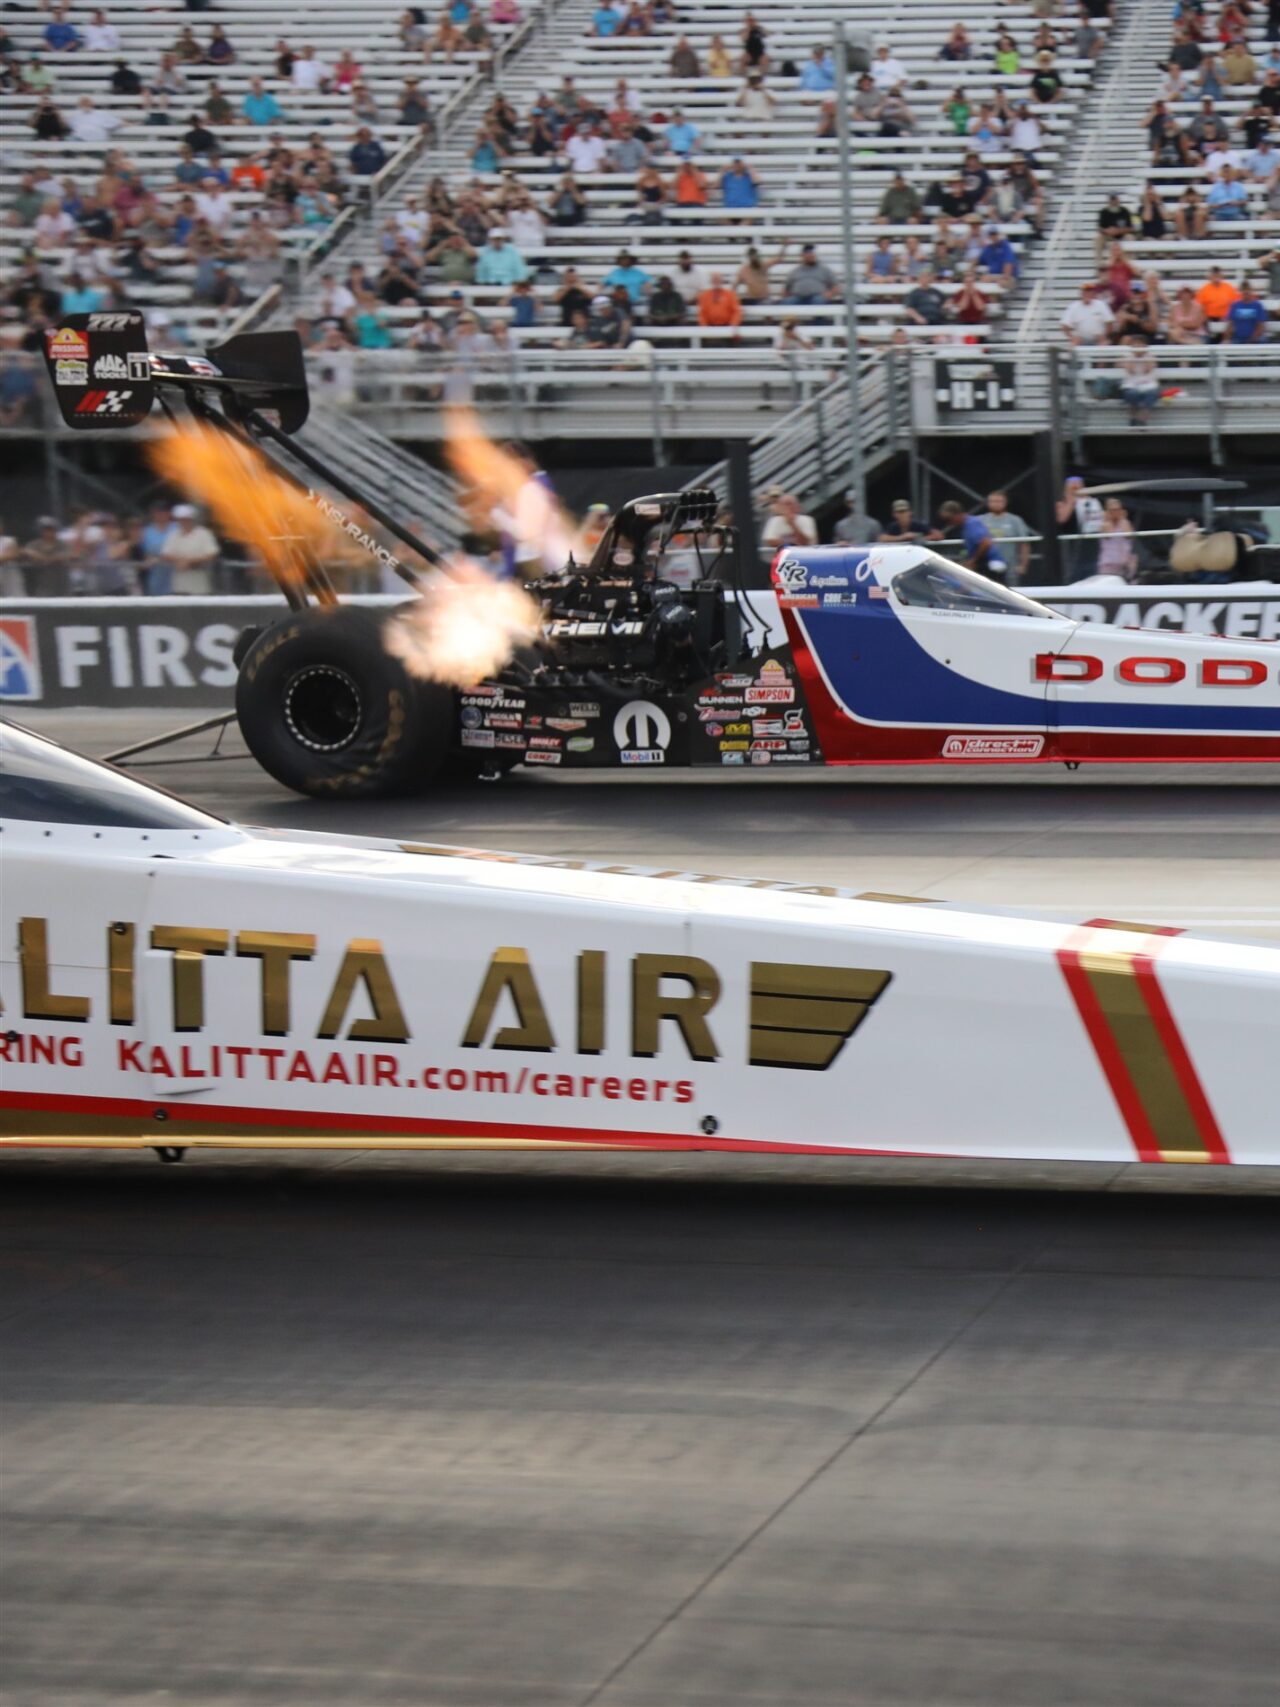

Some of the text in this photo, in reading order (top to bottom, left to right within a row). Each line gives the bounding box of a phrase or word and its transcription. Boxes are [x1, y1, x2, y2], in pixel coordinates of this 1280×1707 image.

[460, 696, 526, 708] GOODYEAR
[748, 690, 791, 700] SIMPSON
[0, 917, 722, 1062] LITTA AIR
[117, 1039, 696, 1104] KALITTAAIR.com/careers
